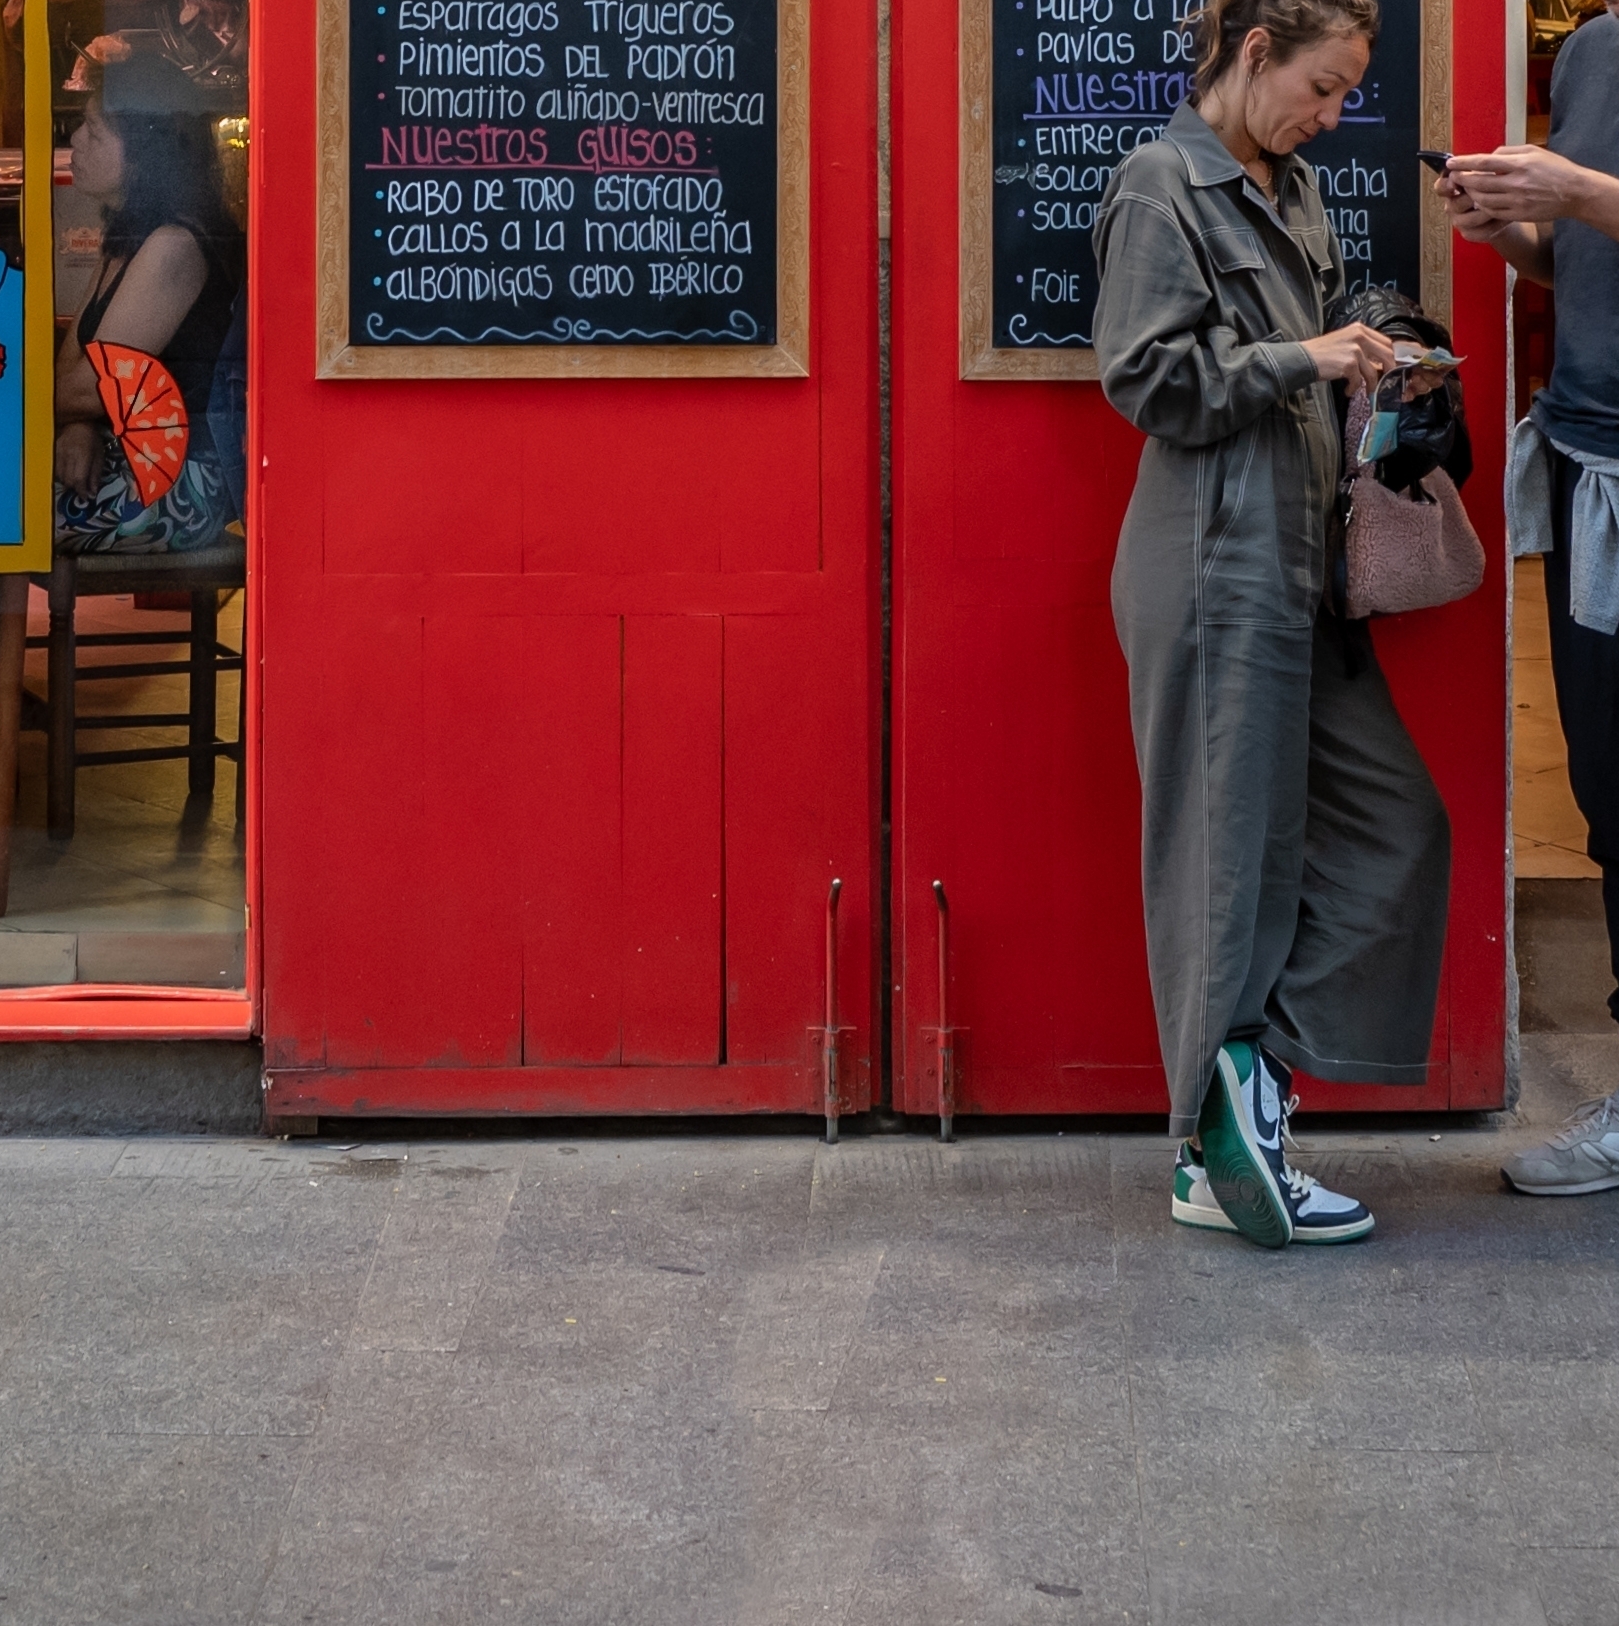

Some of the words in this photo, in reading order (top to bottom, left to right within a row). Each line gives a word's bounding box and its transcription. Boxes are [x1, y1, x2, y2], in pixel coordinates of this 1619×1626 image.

[399, 39, 545, 78] Pimientos
[566, 45, 608, 78] DEL
[395, 84, 525, 119] Tomatito
